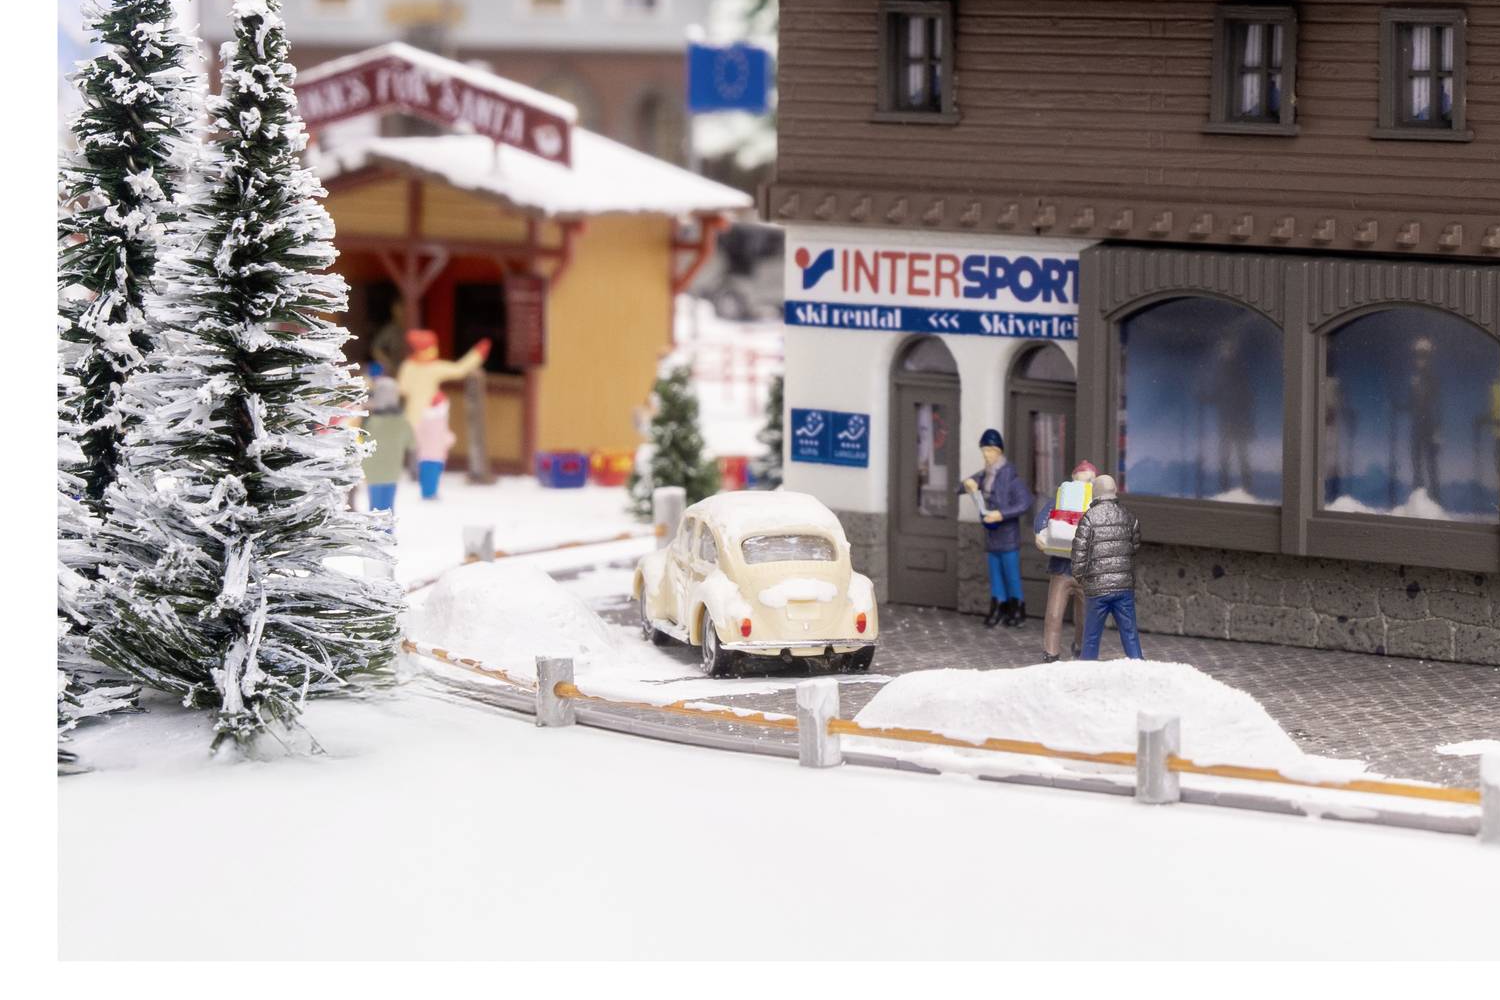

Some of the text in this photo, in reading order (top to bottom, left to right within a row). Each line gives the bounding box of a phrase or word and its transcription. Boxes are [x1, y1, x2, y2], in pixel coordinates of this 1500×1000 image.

[842, 249, 1079, 304] INTERSPORT
[796, 303, 828, 325] ski
[832, 307, 902, 329] rental
